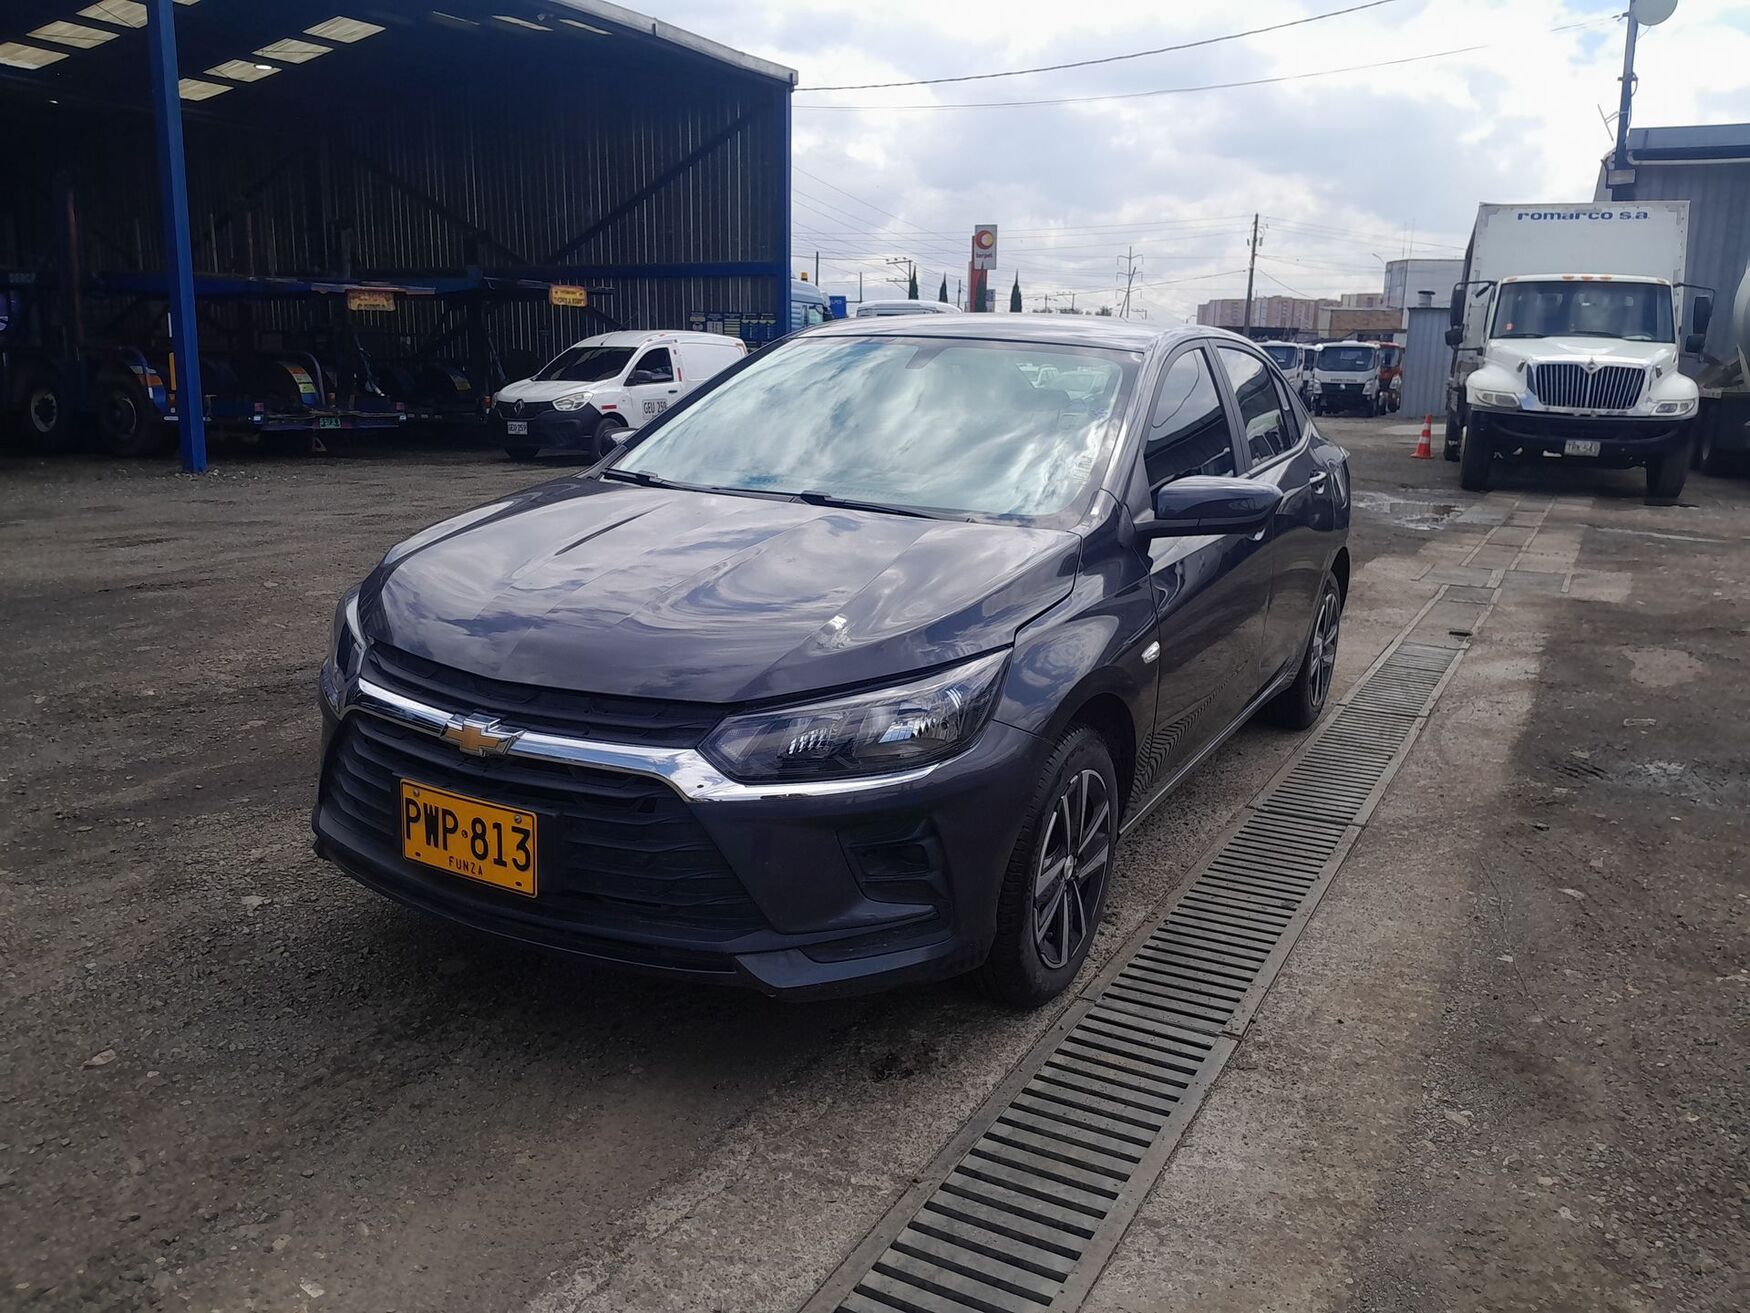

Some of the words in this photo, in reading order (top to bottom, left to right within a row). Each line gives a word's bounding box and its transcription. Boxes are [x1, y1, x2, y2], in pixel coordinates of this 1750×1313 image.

[1517, 211, 1613, 220] romarco
[643, 401, 655, 414] GEU
[405, 797, 459, 851] PWP
[470, 817, 531, 872] 813
[448, 856, 483, 876] FUNZA
